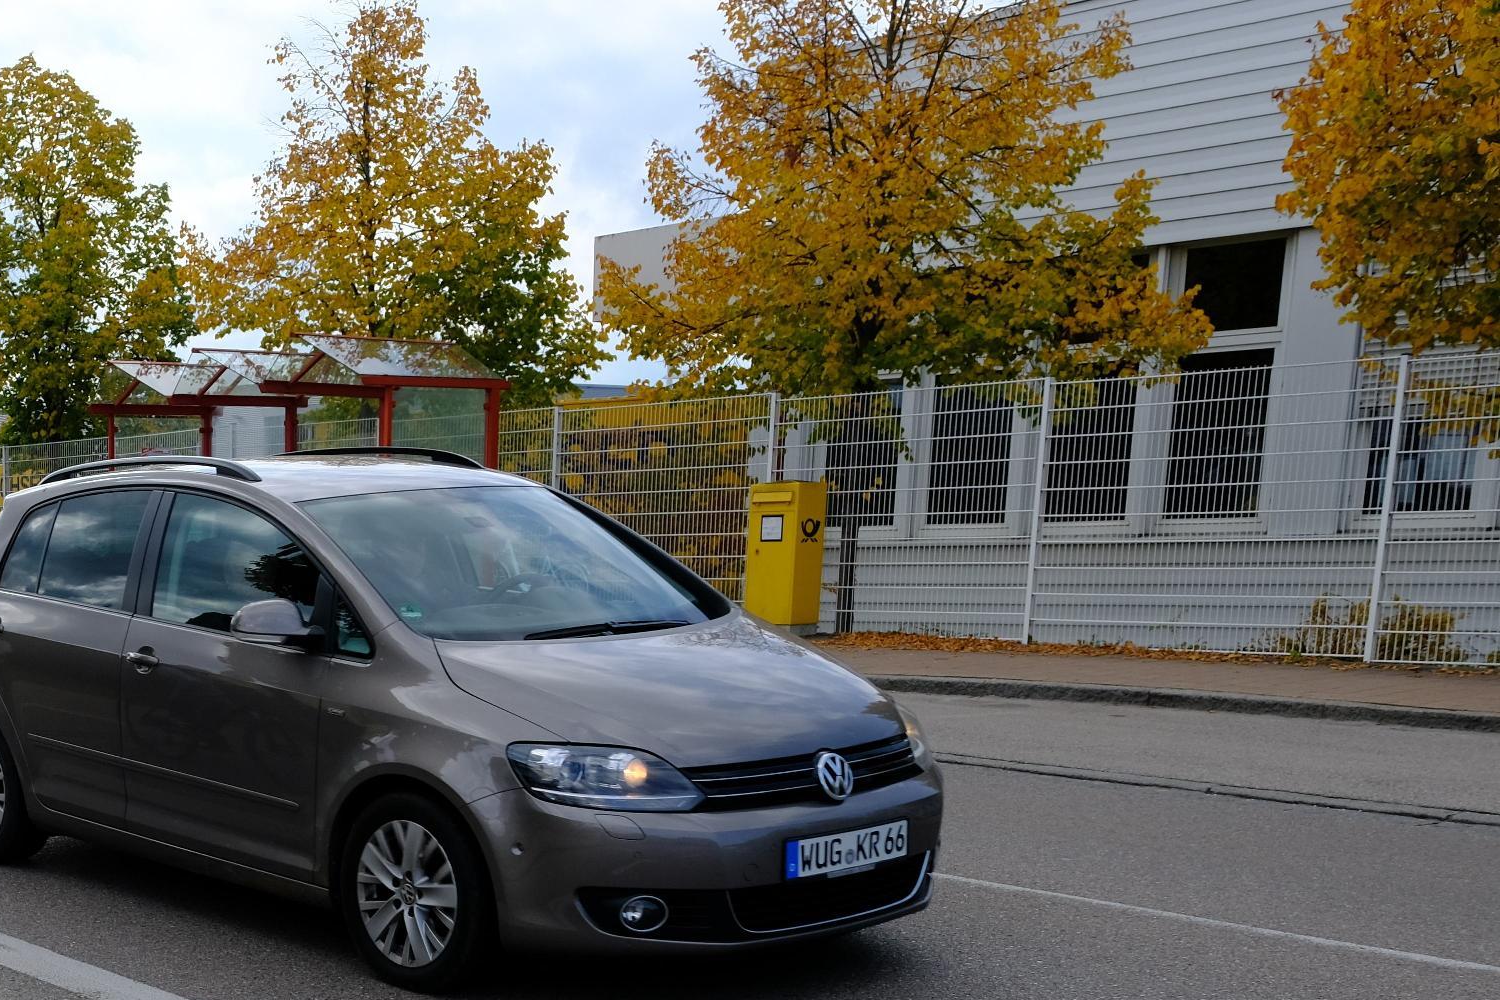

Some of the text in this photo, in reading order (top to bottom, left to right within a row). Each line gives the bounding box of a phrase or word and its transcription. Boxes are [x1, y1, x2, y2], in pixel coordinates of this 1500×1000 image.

[801, 825, 905, 872] WUG KR 66
